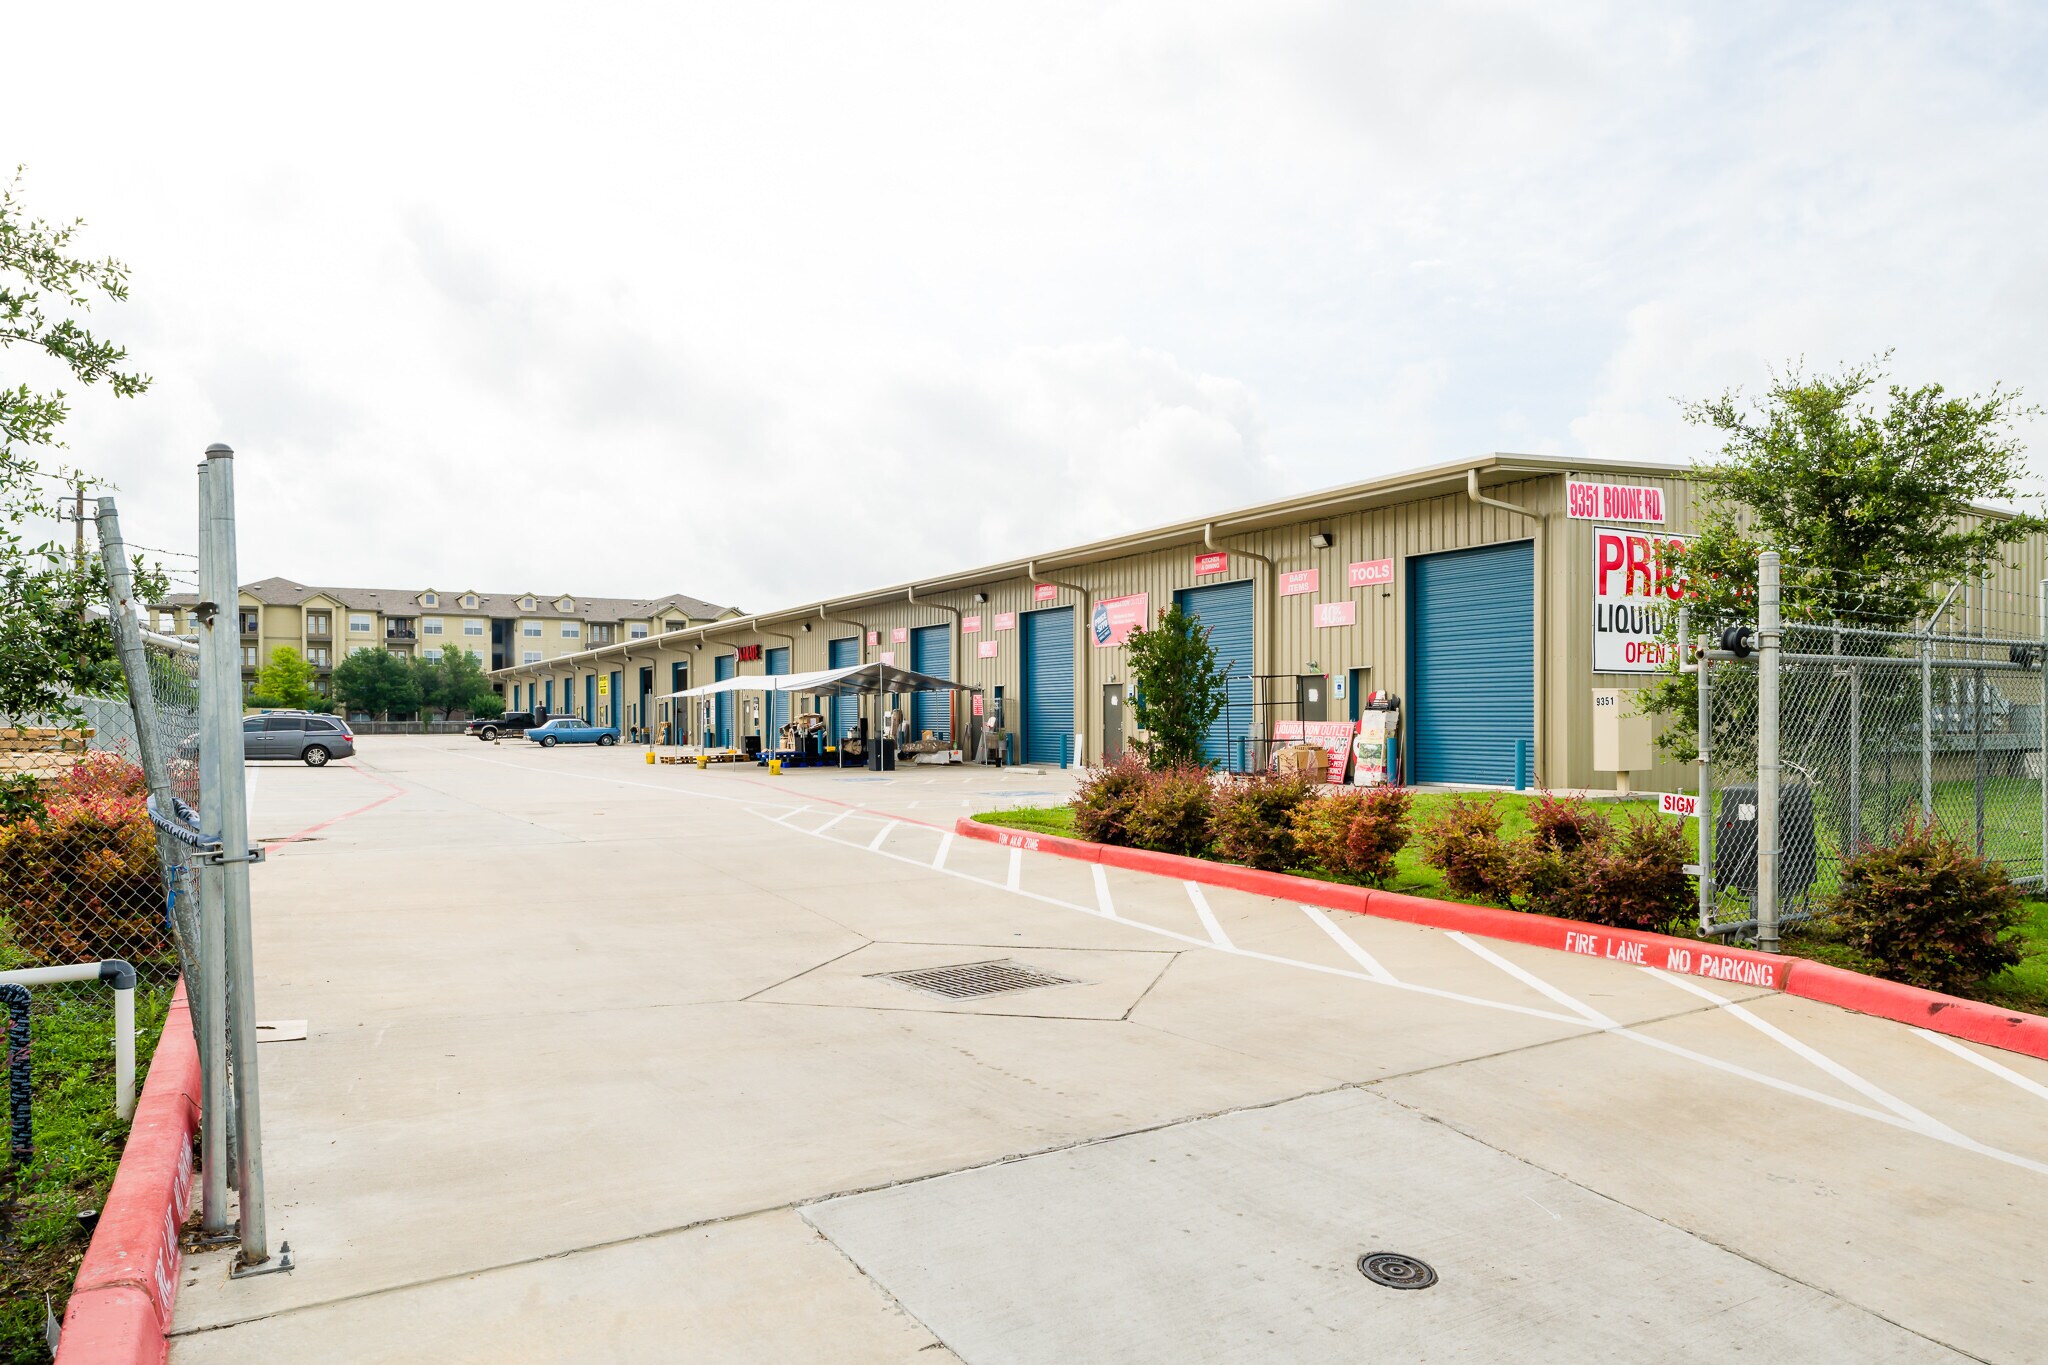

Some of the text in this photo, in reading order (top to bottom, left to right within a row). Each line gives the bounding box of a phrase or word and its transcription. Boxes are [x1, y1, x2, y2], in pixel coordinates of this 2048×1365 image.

[1569, 483, 1663, 520] 9351 BOONE RD.
[1351, 564, 1390, 581] TOOLS
[1598, 534, 1698, 601] PRIC
[1289, 573, 1308, 583] BABY
[1288, 582, 1309, 593] ITEMS
[1625, 641, 1665, 664] OPEN
[1596, 696, 1614, 706] 9351
[1321, 725, 1350, 737] OUTLET
[1663, 795, 1695, 813] SIGN
[1024, 838, 1040, 851] ZONE
[1565, 931, 1774, 987] FIRE LANE NO PARKING
